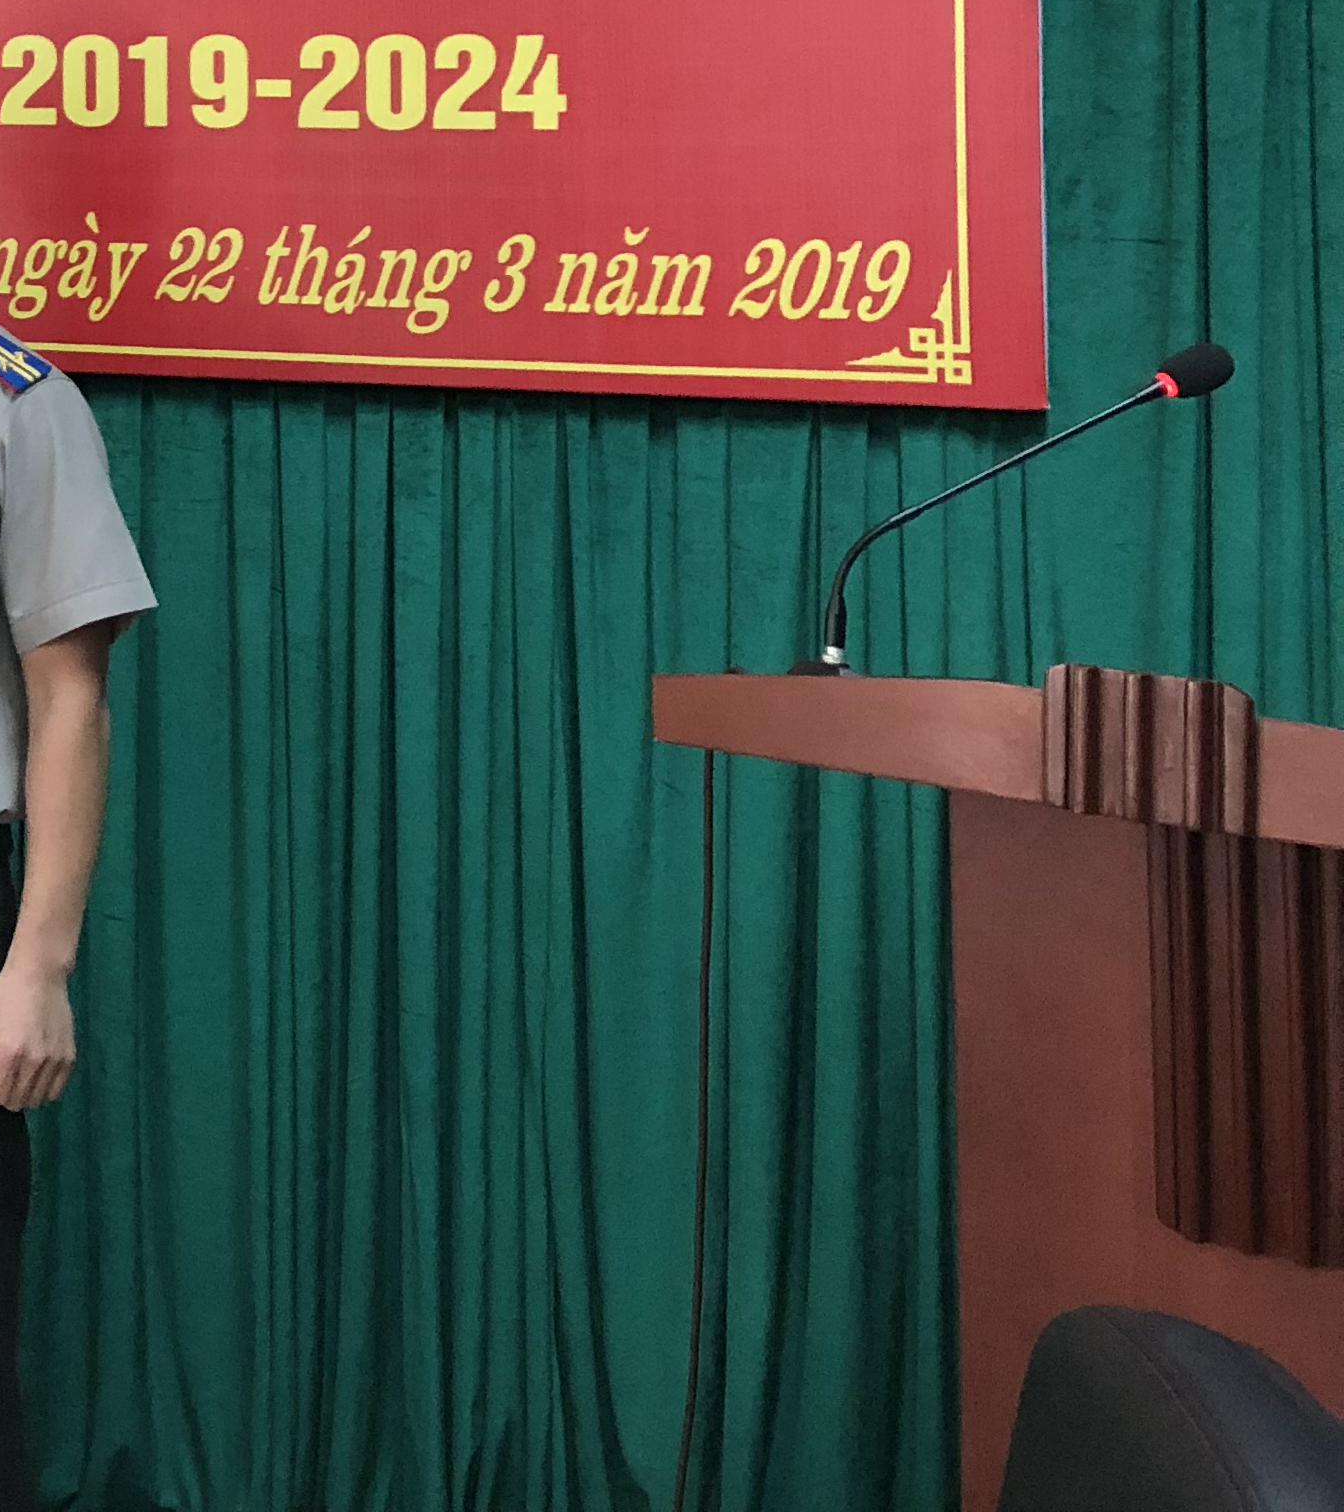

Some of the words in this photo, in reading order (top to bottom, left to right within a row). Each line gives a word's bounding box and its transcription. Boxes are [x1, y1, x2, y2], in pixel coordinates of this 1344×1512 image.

[0, 34, 568, 132] 2019-2024
[155, 227, 243, 304] 22
[257, 223, 471, 336] tháng
[484, 233, 534, 313] 3
[543, 226, 714, 320] năm
[730, 238, 911, 322] 2019
